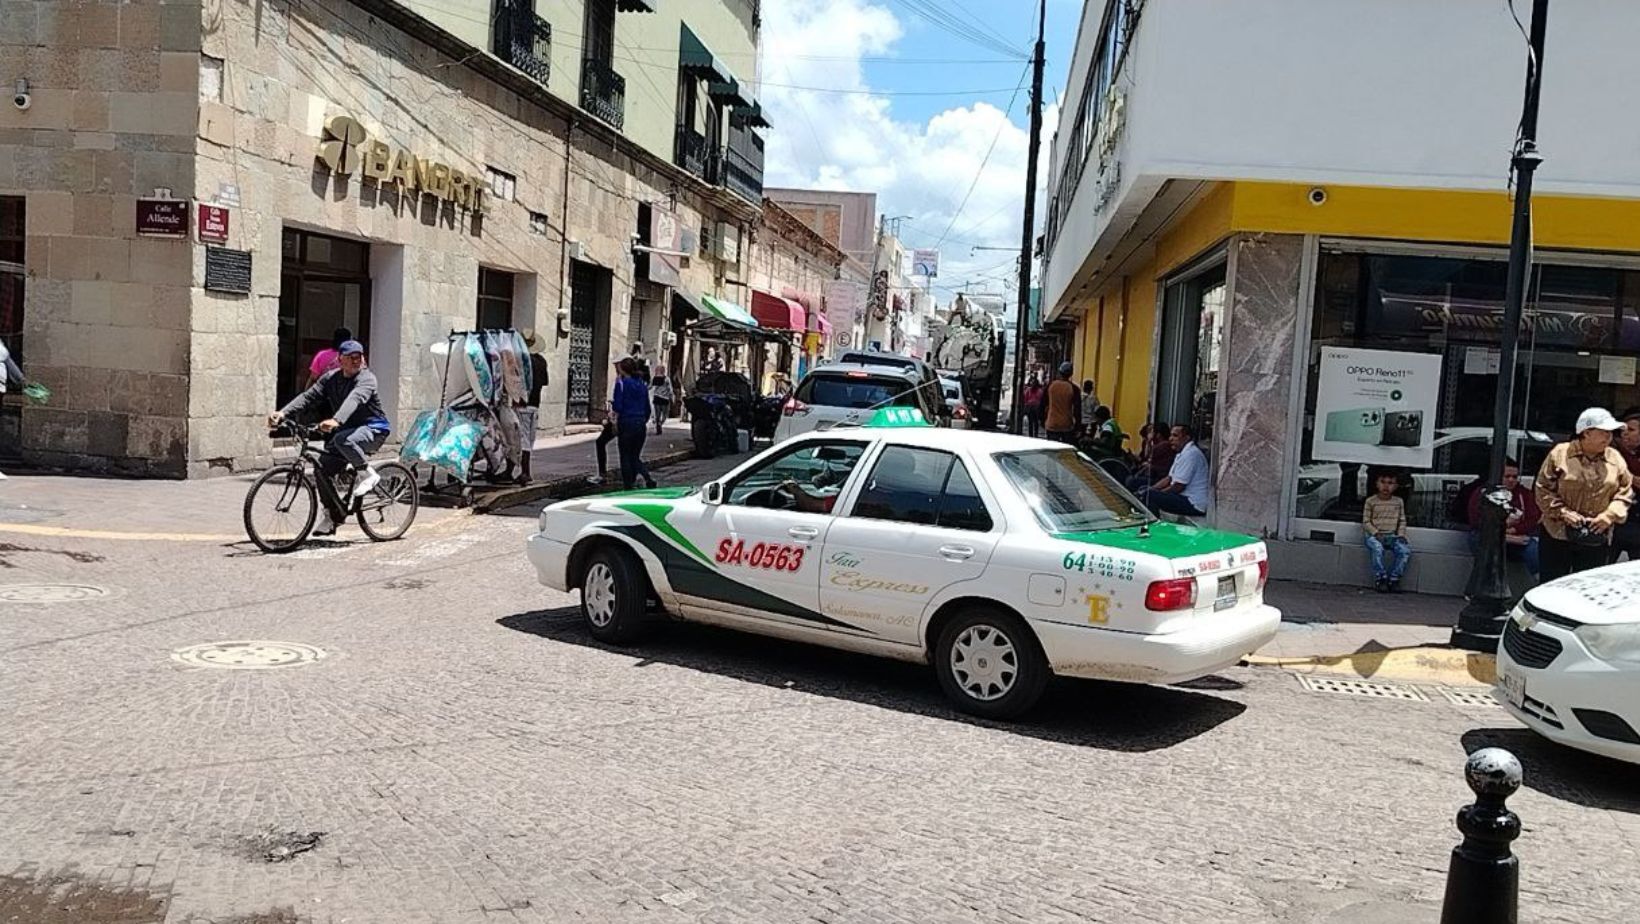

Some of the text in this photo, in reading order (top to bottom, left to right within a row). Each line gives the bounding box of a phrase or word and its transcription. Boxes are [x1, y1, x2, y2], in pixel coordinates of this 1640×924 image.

[146, 213, 181, 224] Allende
[1346, 366, 1375, 376] OPPO
[1375, 367, 1406, 378] Reno11
[1063, 551, 1086, 571] 64
[829, 570, 930, 594] Express
[1086, 594, 1111, 624] E
